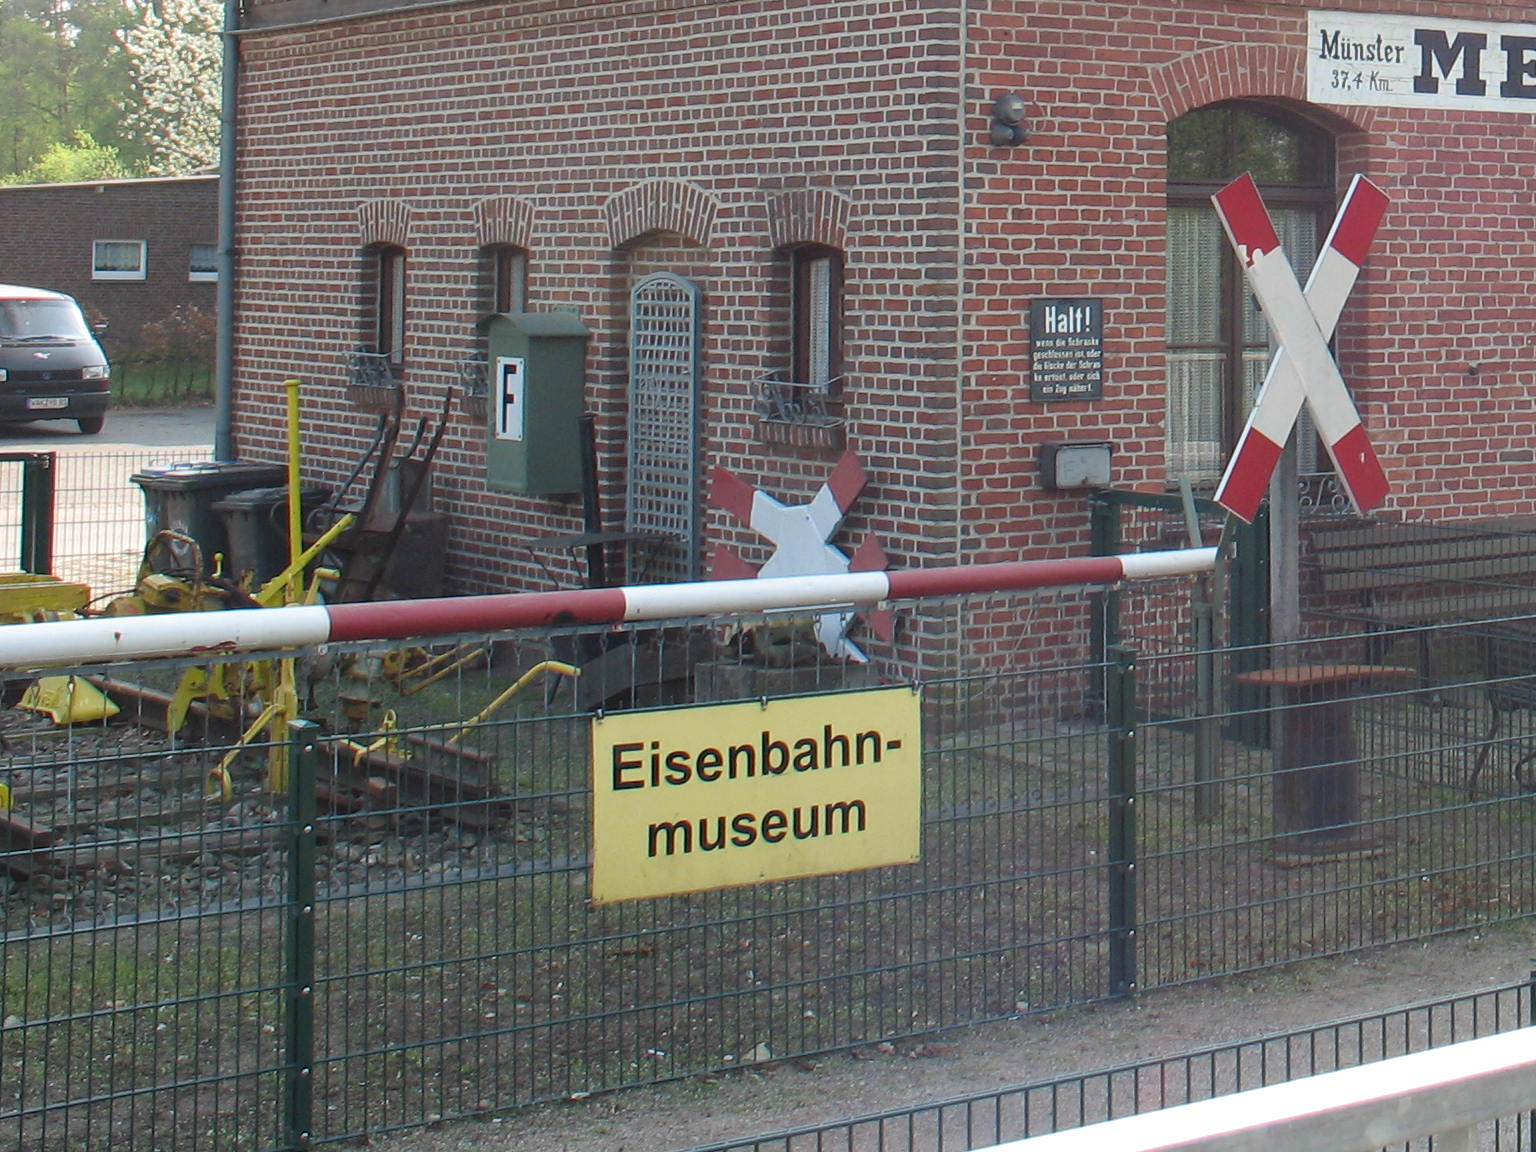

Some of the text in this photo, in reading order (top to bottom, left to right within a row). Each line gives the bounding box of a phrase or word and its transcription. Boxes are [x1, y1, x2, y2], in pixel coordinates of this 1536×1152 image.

[1319, 29, 1405, 63] Münster
[1331, 69, 1363, 91] 37,4
[1045, 306, 1091, 333] Halt!
[1056, 338, 1066, 346] die
[502, 364, 517, 433] F
[612, 724, 902, 791] Eisenbahn-
[648, 798, 866, 858] museum
